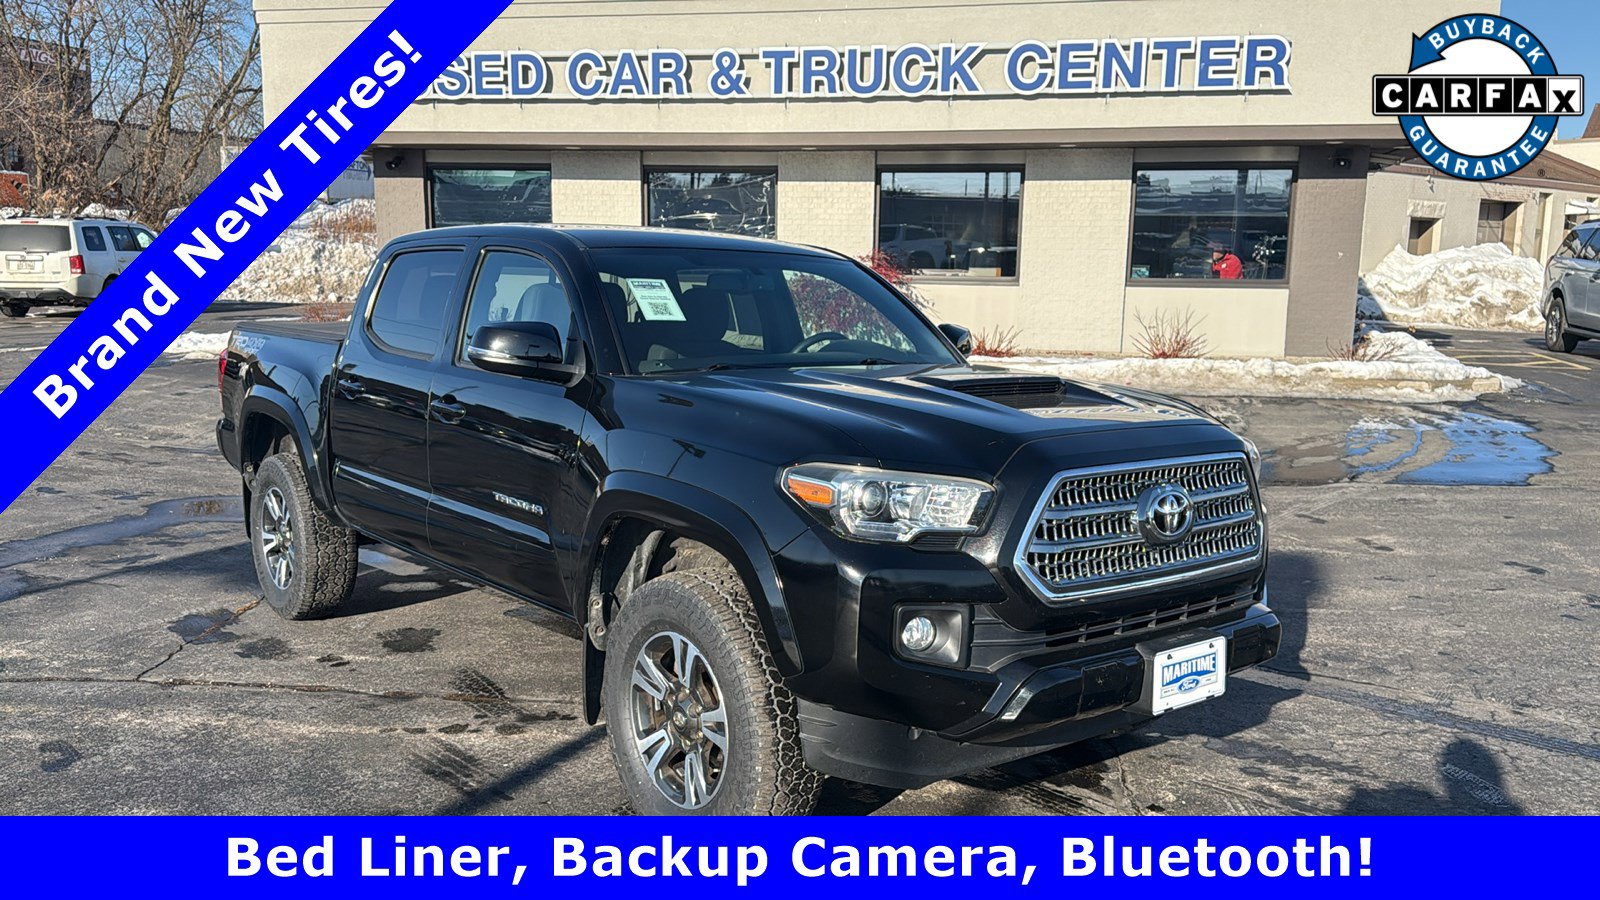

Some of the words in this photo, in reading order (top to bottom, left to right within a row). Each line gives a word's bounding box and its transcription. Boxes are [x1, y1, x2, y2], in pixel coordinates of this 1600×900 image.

[417, 49, 547, 99] SED
[566, 47, 690, 100] CAR
[705, 46, 751, 99] &
[759, 42, 988, 98] TRUCK
[1003, 34, 1292, 95] CENTER
[492, 491, 543, 515] TACOMA
[1163, 654, 1216, 686] MARITIME
[1180, 679, 1199, 691] Ford
